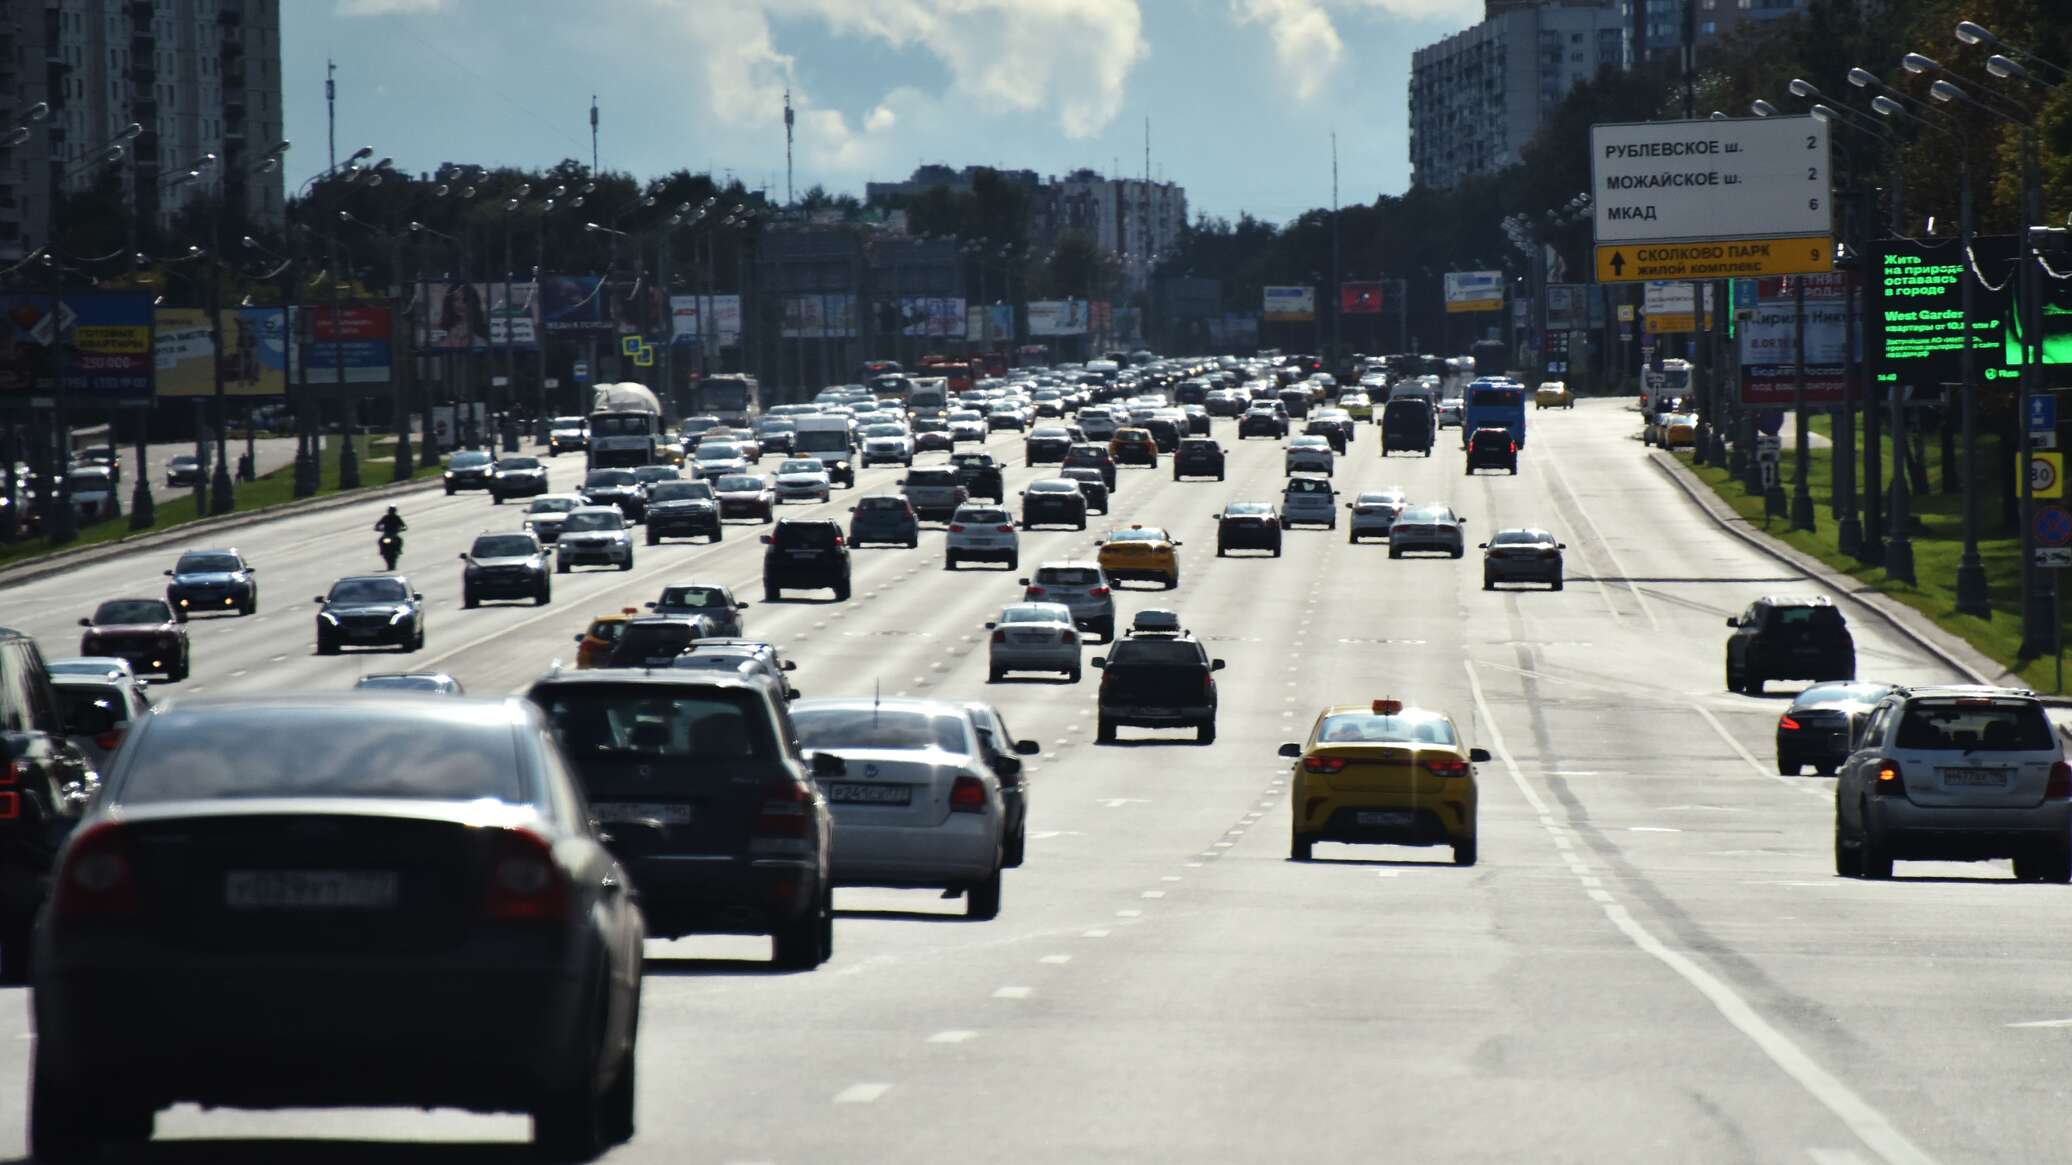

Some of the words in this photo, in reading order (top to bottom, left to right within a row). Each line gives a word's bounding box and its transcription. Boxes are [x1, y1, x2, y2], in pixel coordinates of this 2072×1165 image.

[1606, 140, 1720, 158] РУБЛЕВСКОЕ
[1725, 142, 1743, 154] ш.
[1806, 136, 1817, 150] 2
[1607, 171, 1719, 190] МОЖАЙСКОЕ
[1724, 174, 1742, 185] ш.
[1808, 168, 1818, 181] 2
[1608, 206, 1657, 221] МКАД
[1809, 198, 1818, 211] 6
[1638, 246, 1724, 262] СКОЛКОВО
[1728, 244, 1770, 258] ПАРК
[1810, 249, 1820, 261] 9
[1884, 254, 1922, 264] Жить
[1884, 266, 1902, 276] на
[1904, 264, 1965, 276] природе
[1884, 276, 1958, 286] оставаясь
[1884, 288, 1894, 296] в
[1896, 286, 1946, 297] городе
[1884, 311, 1917, 321] West
